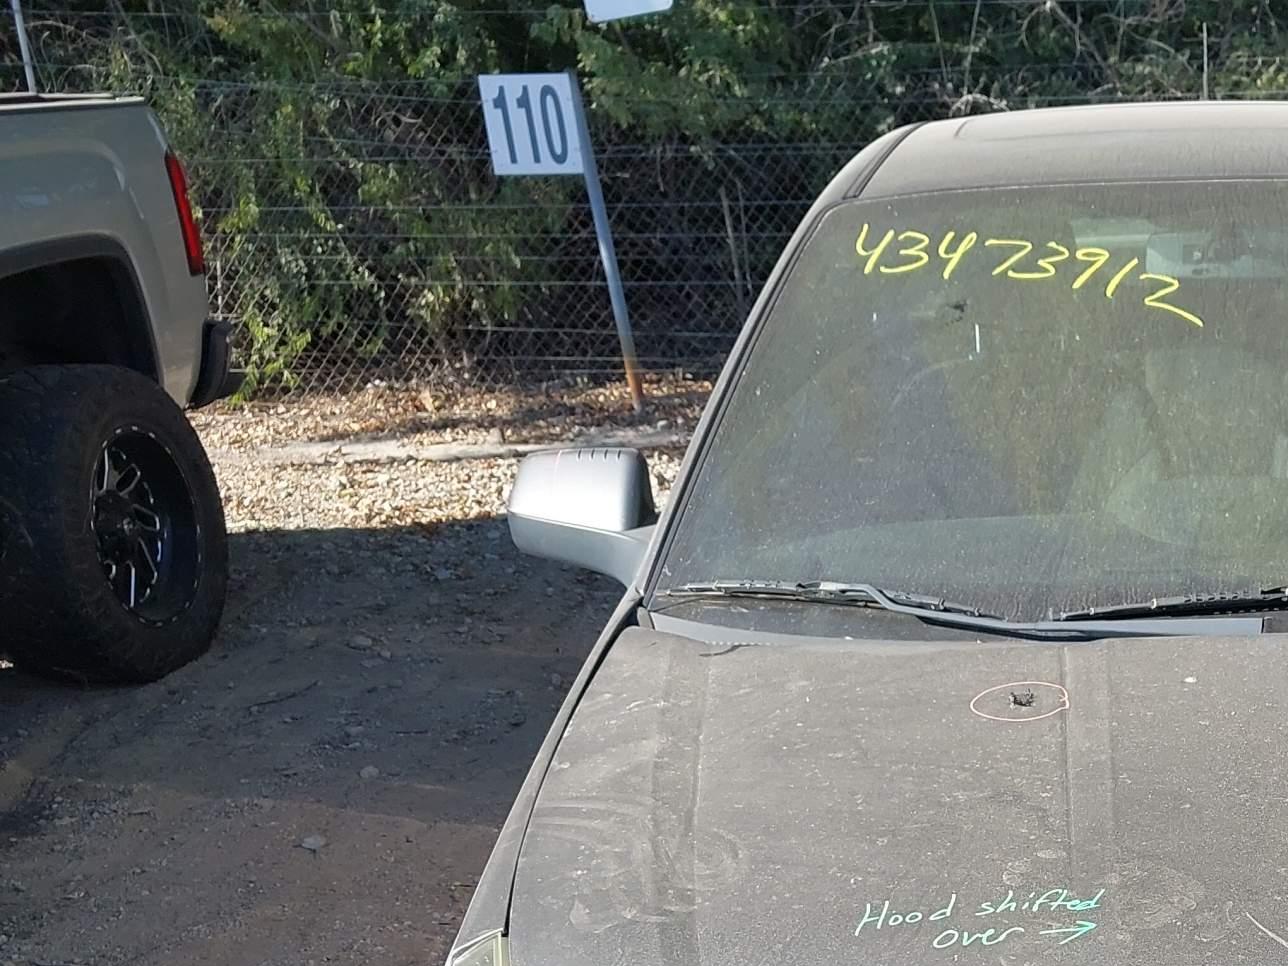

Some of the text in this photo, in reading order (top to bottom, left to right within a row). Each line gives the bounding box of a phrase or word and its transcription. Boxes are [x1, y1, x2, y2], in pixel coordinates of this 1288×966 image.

[492, 85, 568, 165] 110
[855, 223, 1204, 327] 43473912
[855, 888, 1105, 936] Hood shifted
